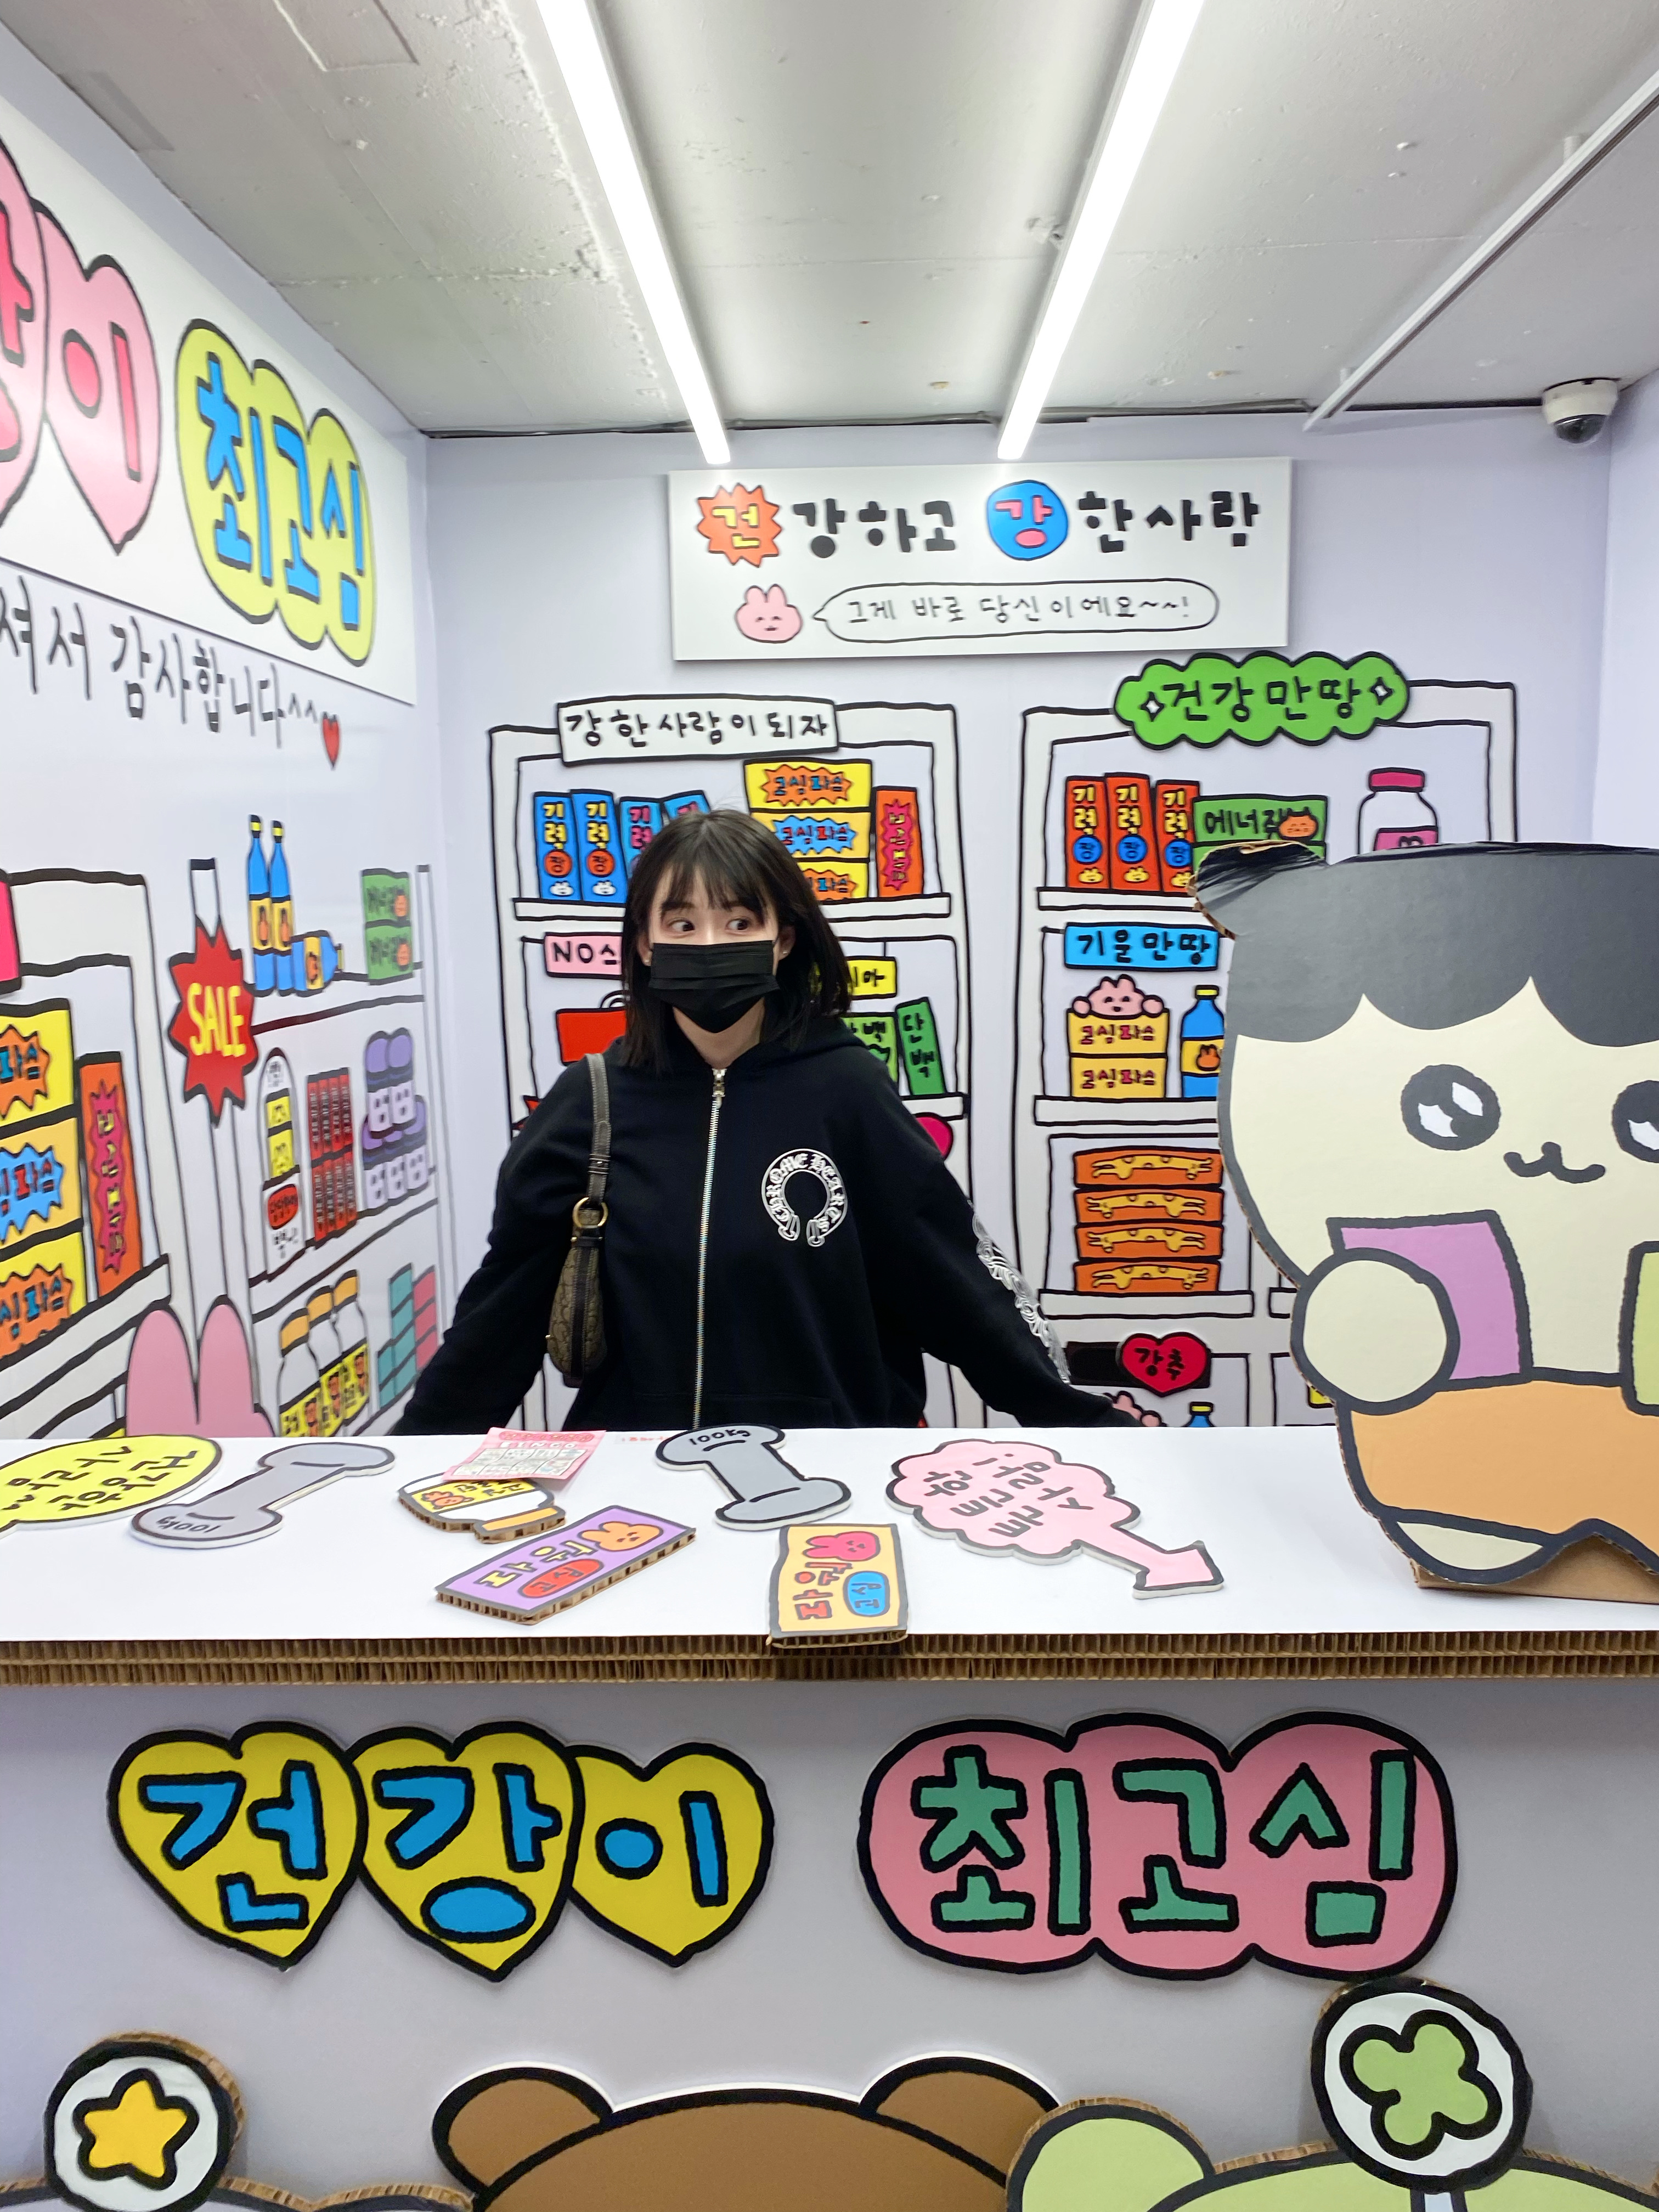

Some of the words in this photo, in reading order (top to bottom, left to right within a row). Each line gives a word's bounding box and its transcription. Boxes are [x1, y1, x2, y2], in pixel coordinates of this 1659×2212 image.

[195, 351, 365, 631] 최고심
[848, 597, 896, 623] 그게
[915, 596, 965, 622] 바로
[774, 775, 843, 795] 고심파스
[781, 825, 848, 845] 고심파스
[188, 982, 248, 1058] SALE
[1080, 1024, 1154, 1045] 고심파스
[1081, 1068, 1155, 1090] 고심파스
[1133, 1345, 1186, 1379] 강추
[689, 1429, 751, 1445] 100kg
[923, 1470, 1045, 1538] 튼튼한
[154, 1515, 222, 1534] 100kg
[139, 1758, 730, 1944] 건강이
[909, 1745, 1417, 1948] 최고심
